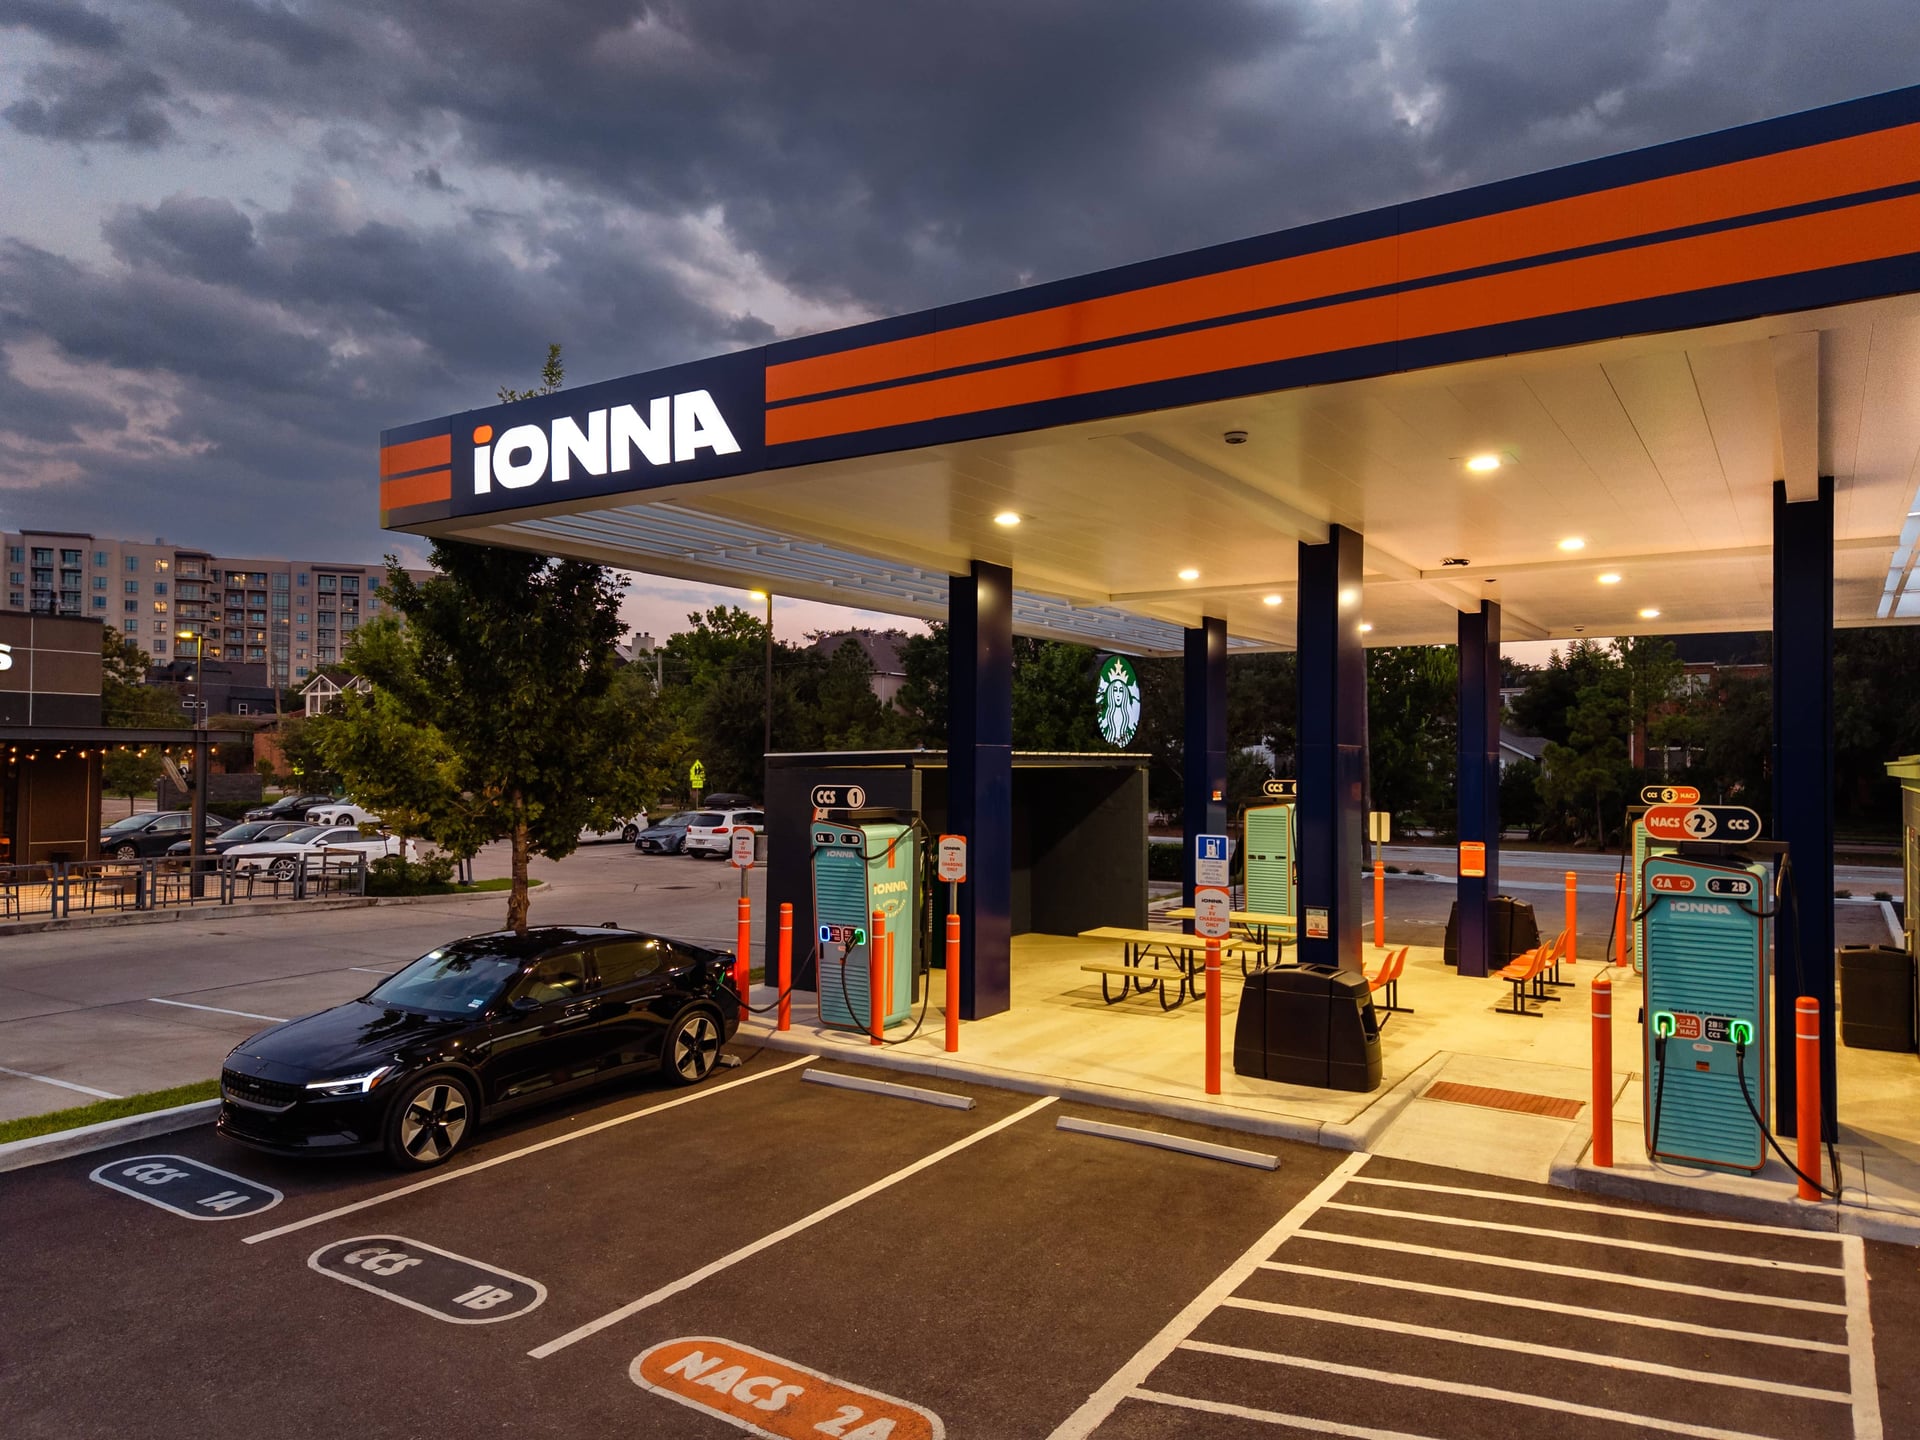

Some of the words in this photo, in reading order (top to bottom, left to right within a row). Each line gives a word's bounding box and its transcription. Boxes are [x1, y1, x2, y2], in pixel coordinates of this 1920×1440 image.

[1268, 783, 1284, 793] CCS
[1646, 791, 1658, 799] CCS
[1666, 790, 1673, 801] 3
[817, 790, 836, 804] CCS
[853, 791, 858, 805] 1
[1650, 817, 1680, 828] NACS
[1694, 814, 1706, 832] 2
[1727, 819, 1750, 830] CCS
[1656, 878, 1672, 889] 2A
[1731, 882, 1747, 893] 2B
[1686, 1018, 1697, 1026] 2A
[122, 1163, 190, 1185] CCS
[196, 1190, 251, 1212] 1A
[343, 1247, 423, 1276] CCS
[452, 1285, 513, 1310] 1B
[663, 1350, 805, 1411] NACS
[813, 1405, 897, 1440] 2A
